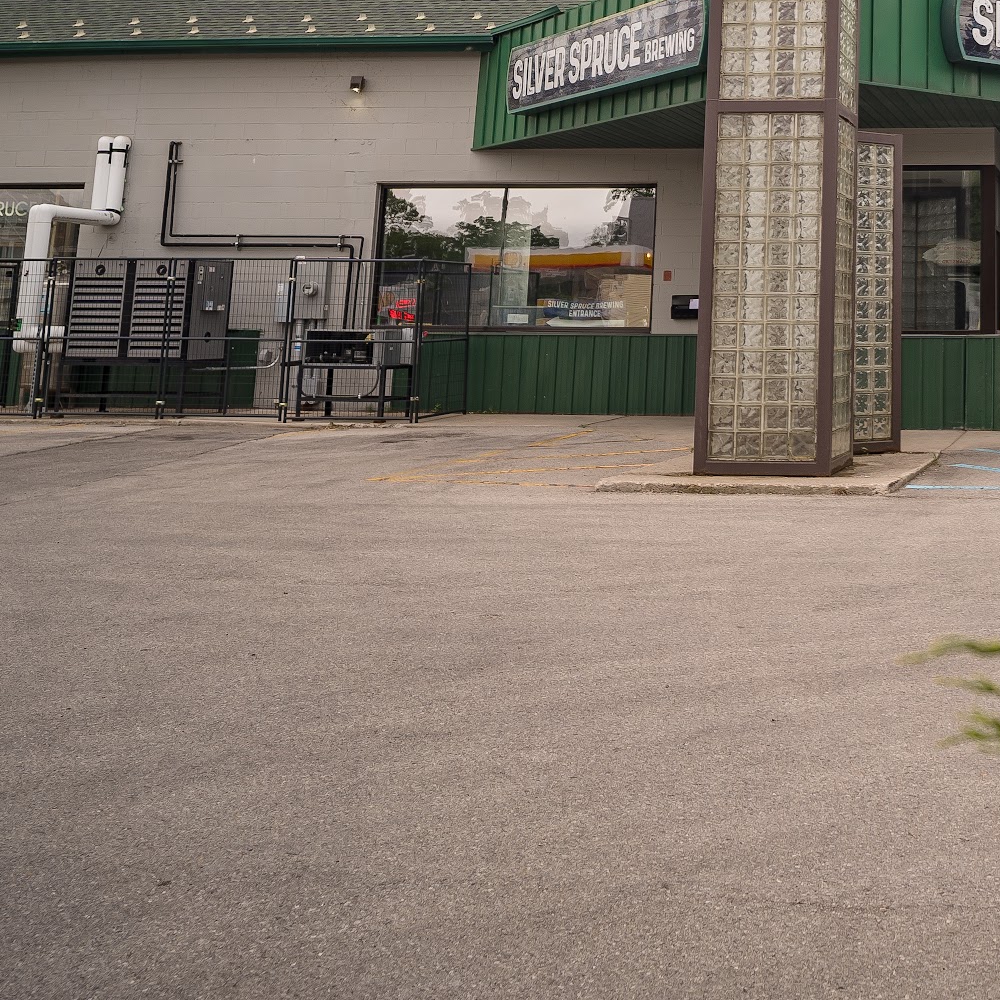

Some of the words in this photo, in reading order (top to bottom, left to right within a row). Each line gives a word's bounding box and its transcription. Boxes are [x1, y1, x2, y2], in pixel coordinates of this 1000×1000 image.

[512, 46, 565, 99] SILVER
[568, 22, 642, 84] SPRUCE
[644, 28, 695, 64] BREWING
[547, 300, 569, 308] SILVER
[595, 300, 624, 309] BREWING
[568, 309, 601, 318] ENTRANCE
